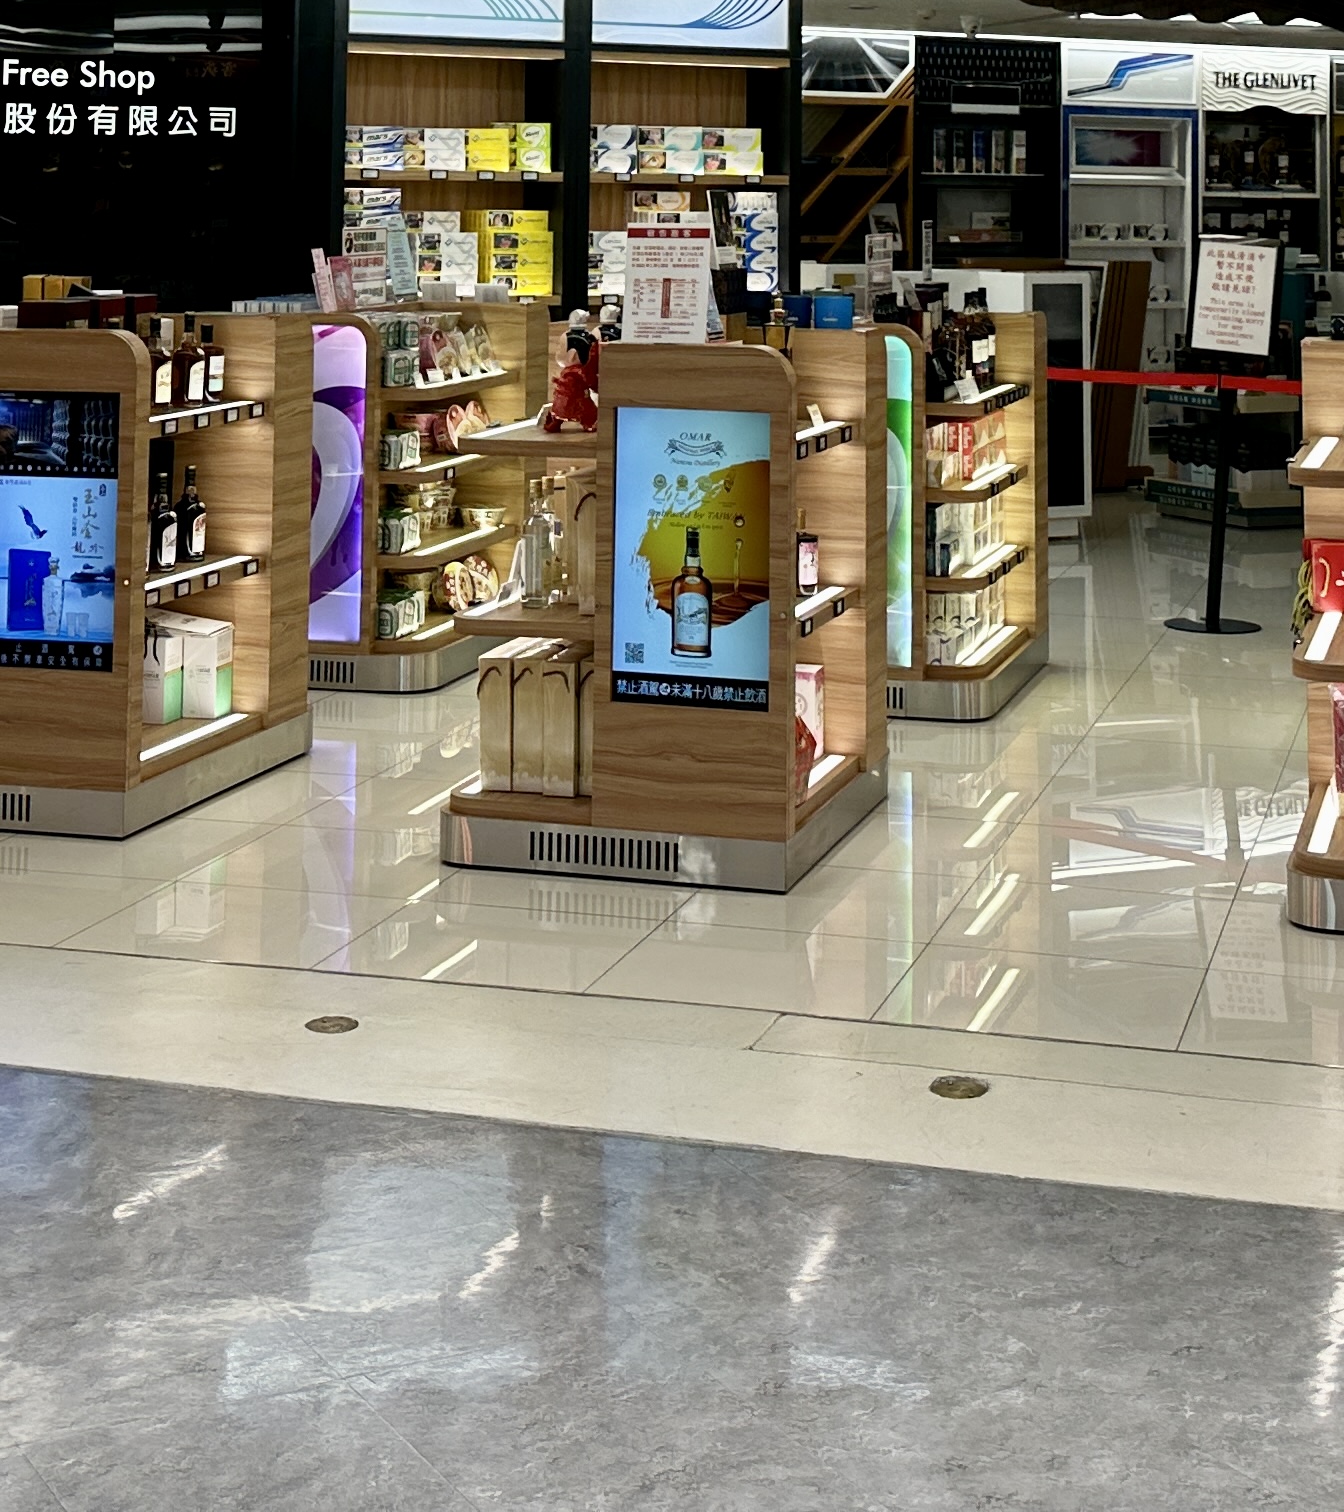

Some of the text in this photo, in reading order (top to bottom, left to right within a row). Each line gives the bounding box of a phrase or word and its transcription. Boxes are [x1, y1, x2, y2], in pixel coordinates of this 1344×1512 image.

[2, 60, 69, 88] Free
[80, 61, 155, 95] Shop
[1214, 72, 1317, 90] THE GLENLIVET
[679, 432, 712, 441] OMAR
[617, 679, 766, 704] 禁止酒駕 未滿十八歲禁止飲酒
